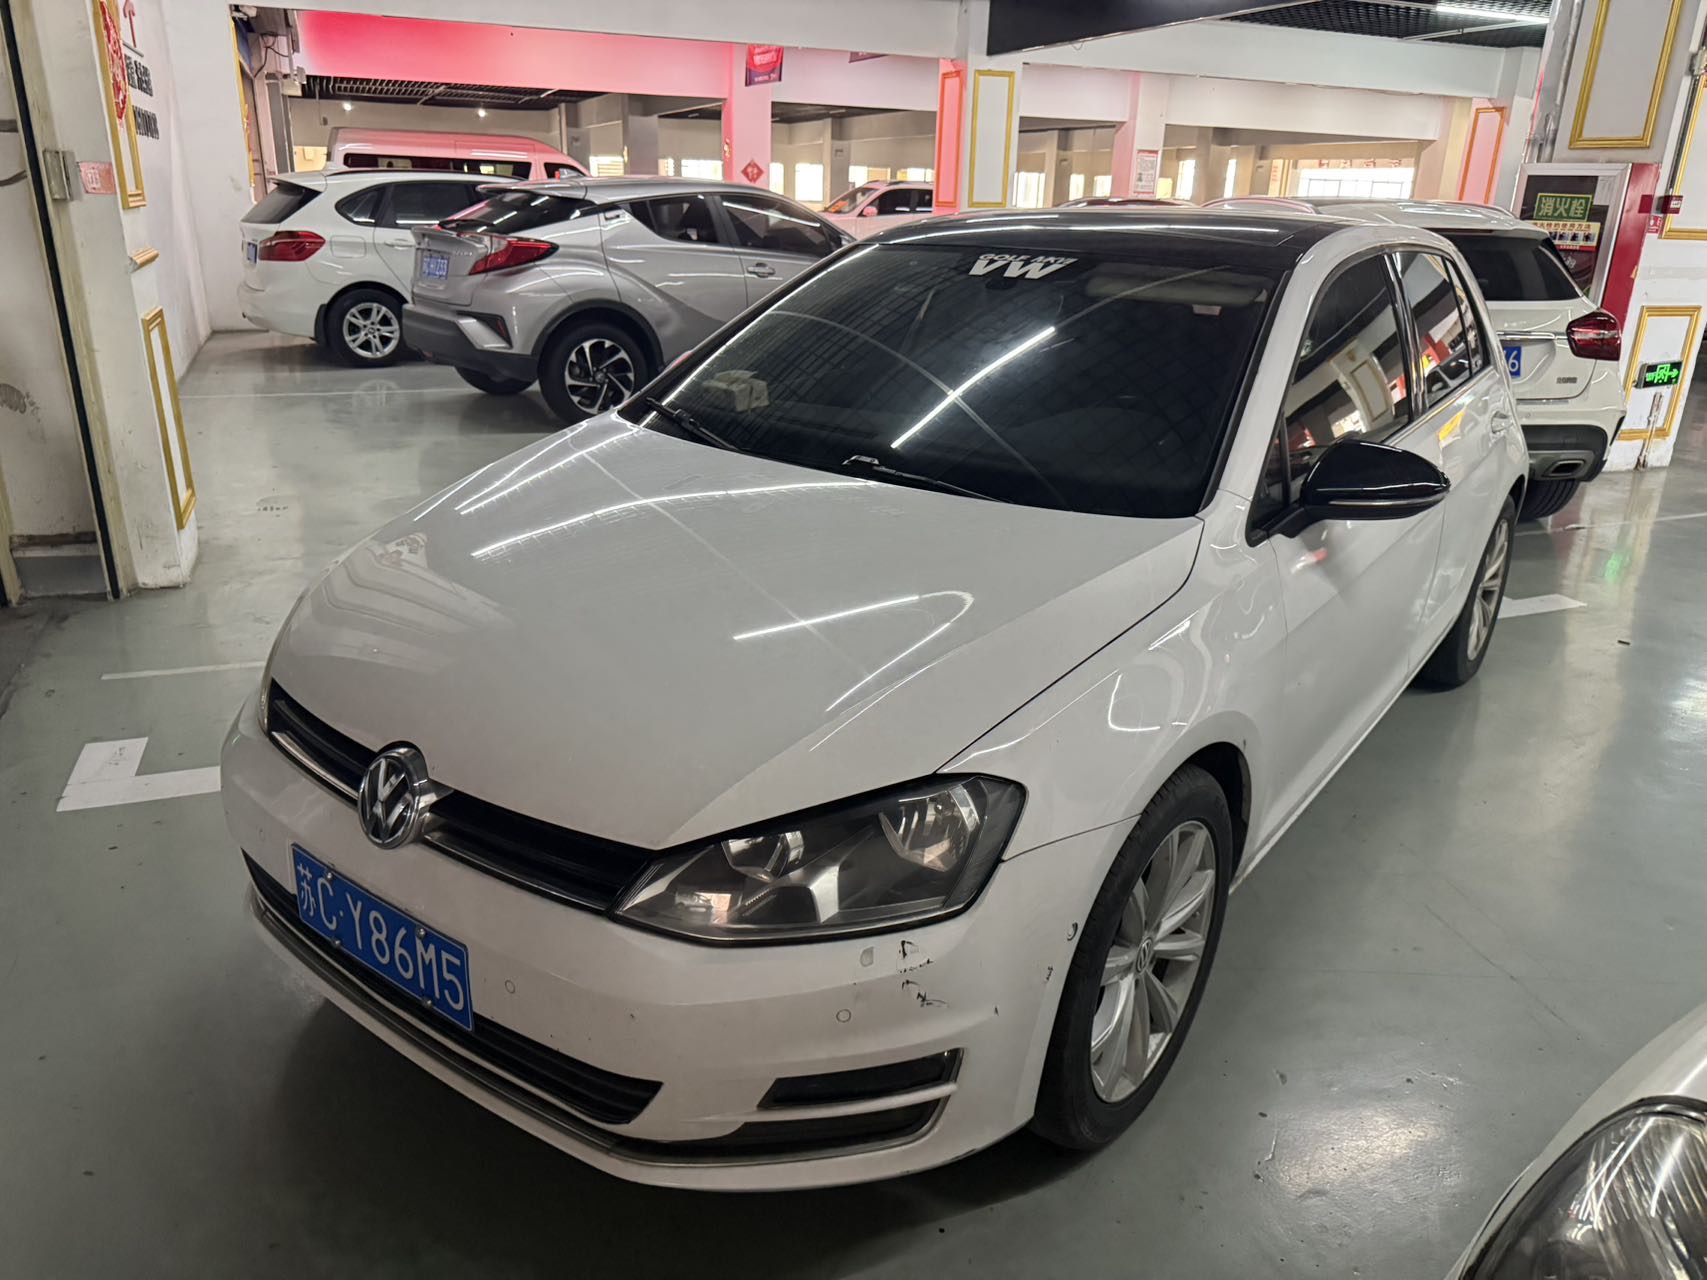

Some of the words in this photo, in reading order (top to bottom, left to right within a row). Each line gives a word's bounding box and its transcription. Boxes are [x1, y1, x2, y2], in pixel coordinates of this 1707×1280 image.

[1538, 195, 1586, 218] 消火栓
[979, 253, 1031, 262] GOLF
[968, 259, 1066, 279] VW
